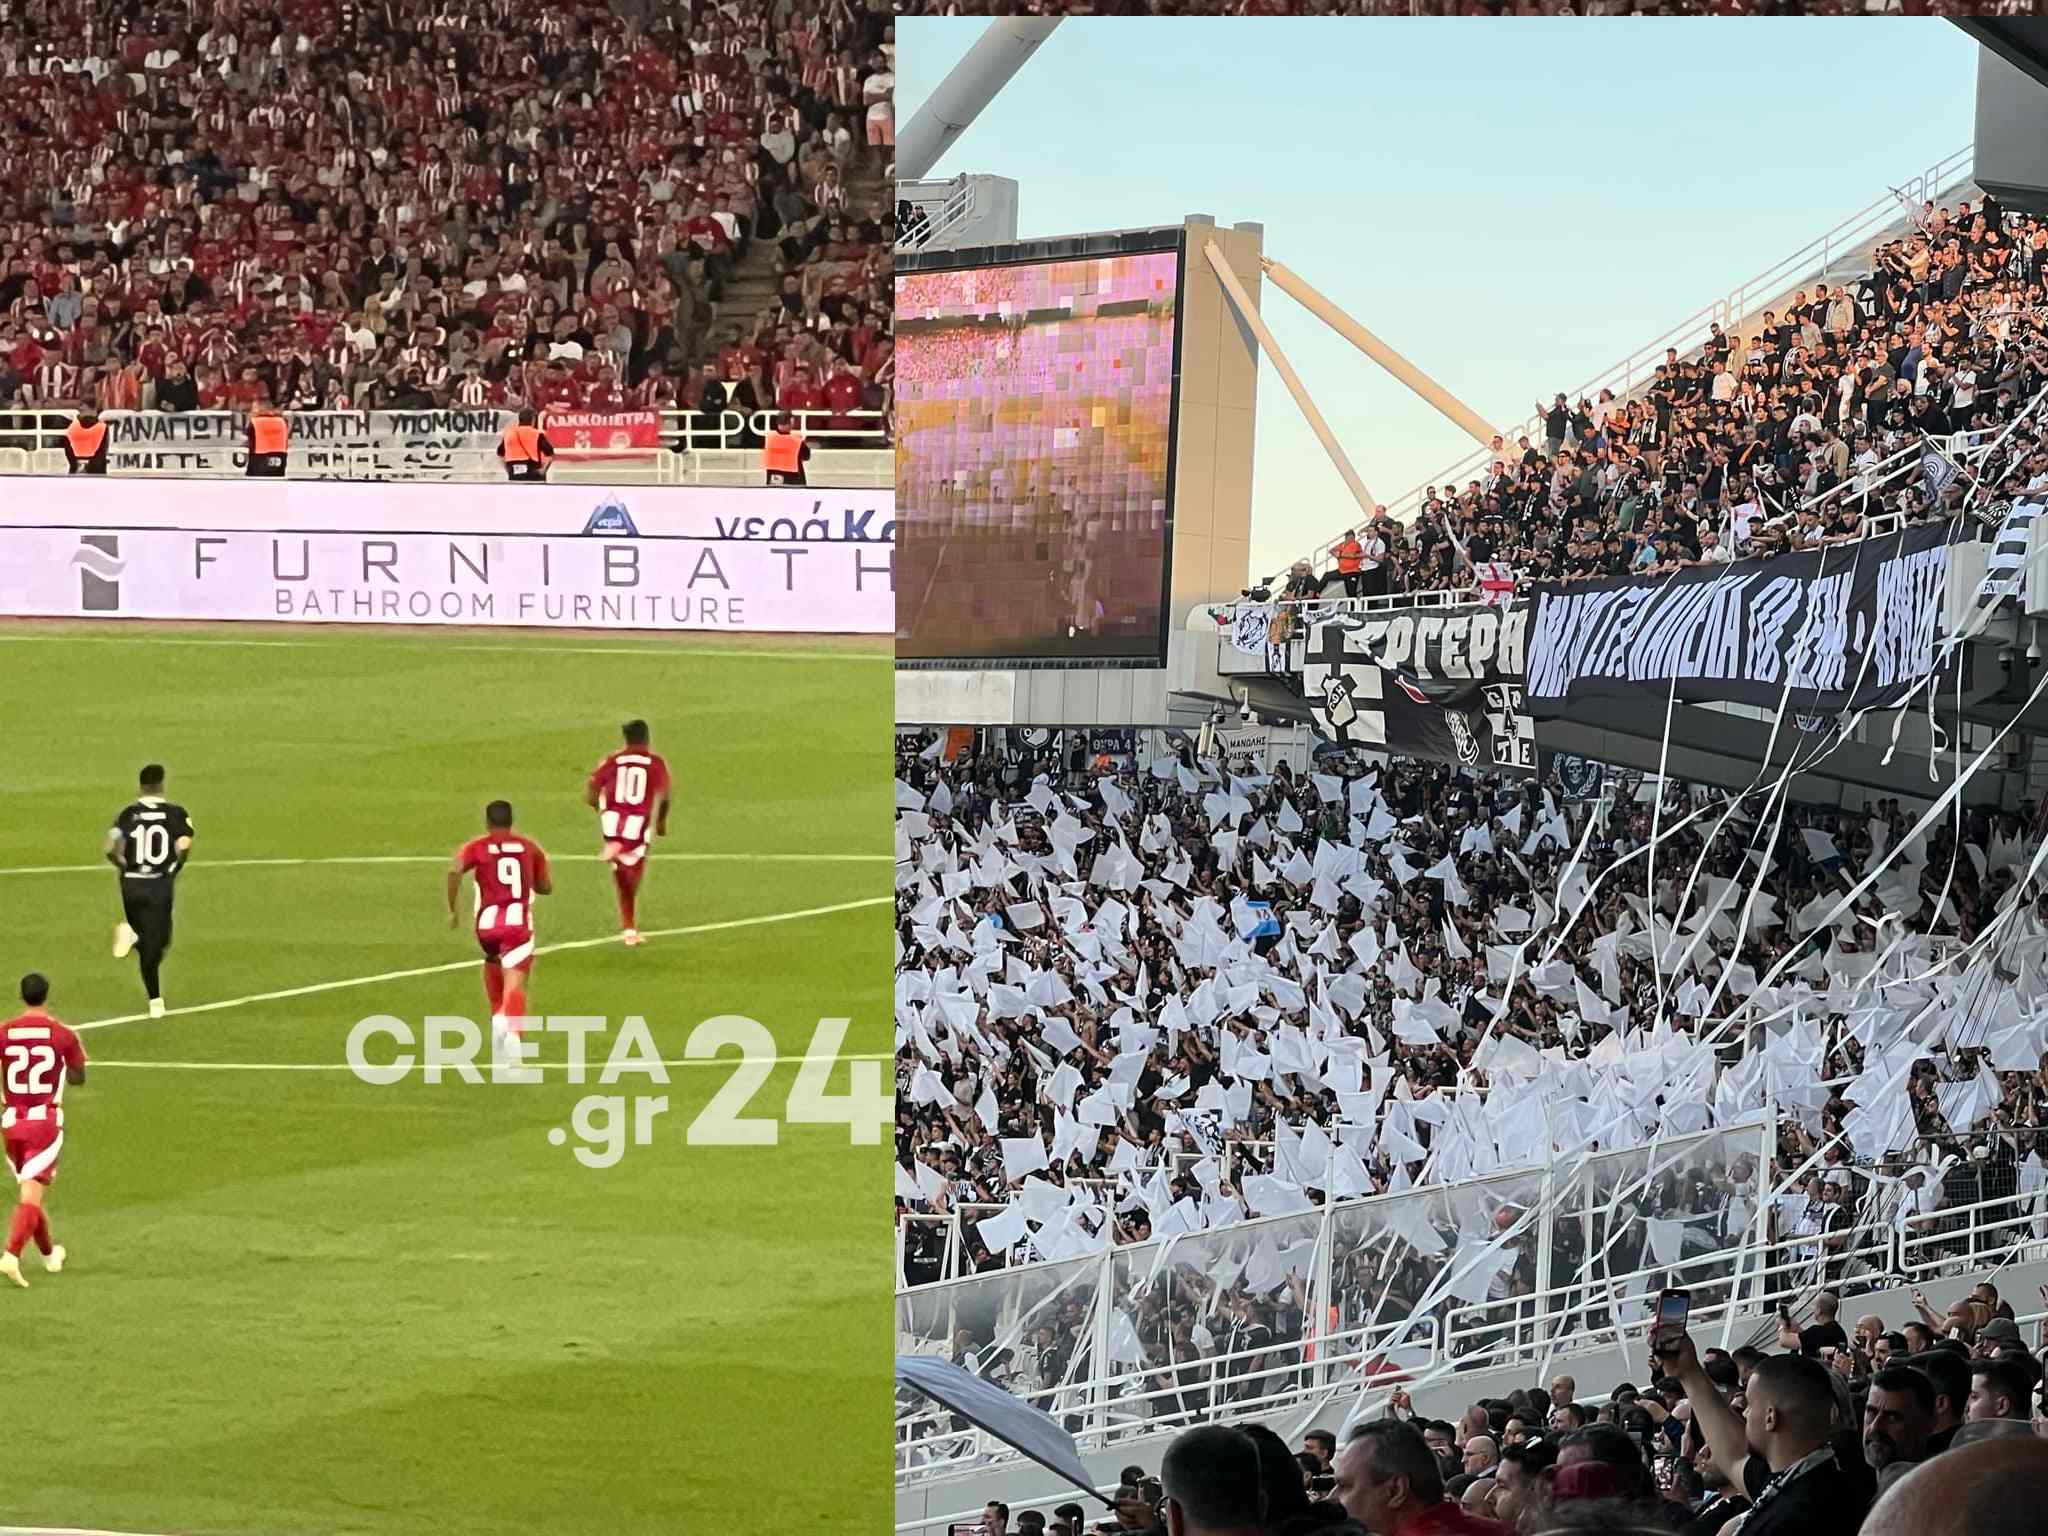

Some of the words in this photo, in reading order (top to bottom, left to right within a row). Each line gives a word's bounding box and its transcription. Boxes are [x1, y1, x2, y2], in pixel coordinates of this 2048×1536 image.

[390, 411, 499, 435] ΥΠΟΜΟΝΗ
[275, 588, 495, 619] BATHROOM
[518, 592, 745, 624] FURNITURE
[1124, 738, 1132, 751] 4
[615, 765, 648, 806] 10
[130, 823, 169, 865] 10
[497, 856, 522, 899] 9
[4, 1045, 56, 1095] 22
